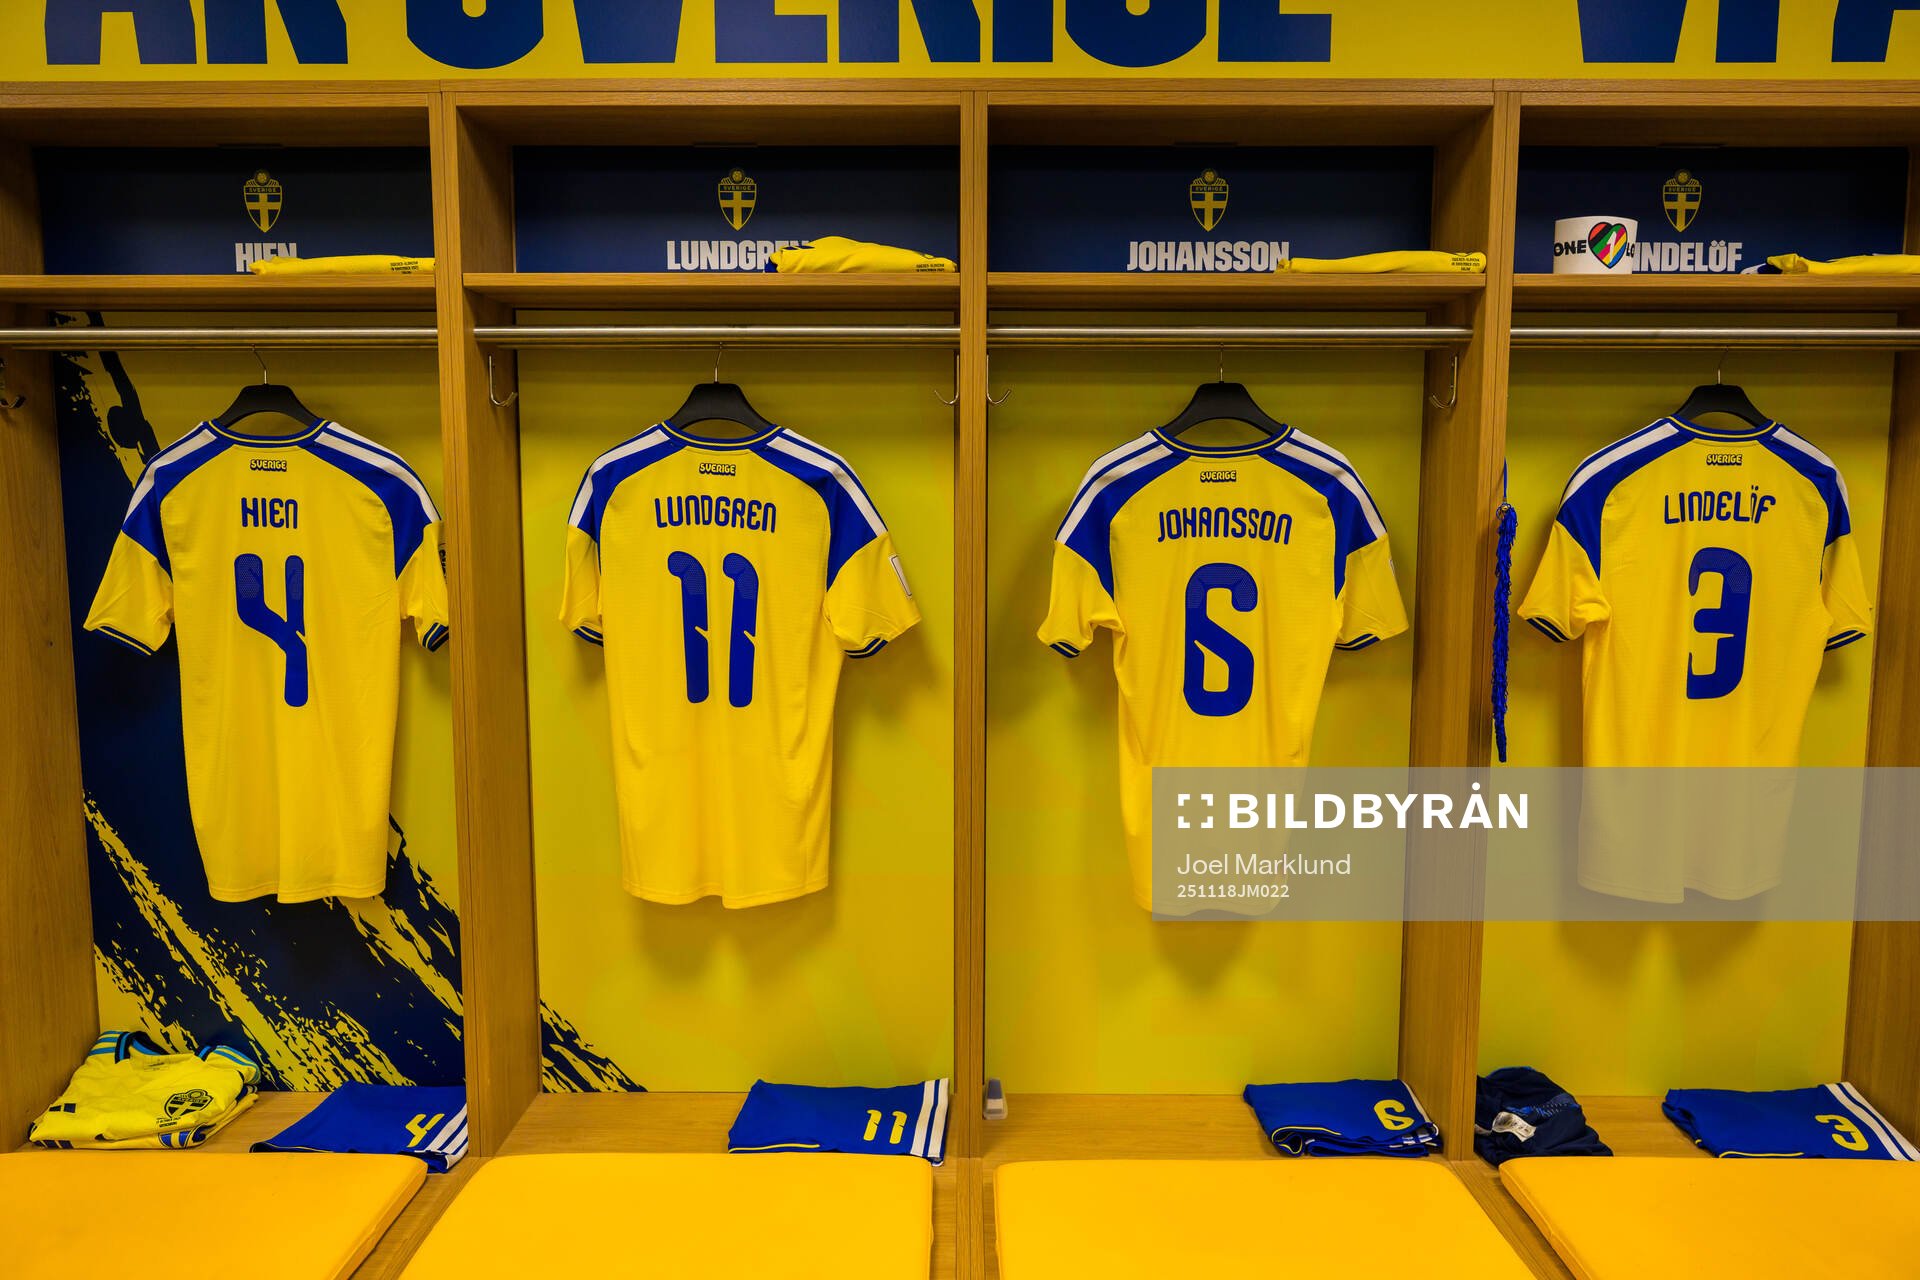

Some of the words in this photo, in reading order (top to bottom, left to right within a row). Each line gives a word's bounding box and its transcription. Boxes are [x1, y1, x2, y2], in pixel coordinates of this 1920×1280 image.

[666, 240, 810, 272] LUNDGR
[1126, 240, 1290, 272] JOHANSSON
[1554, 240, 1587, 257] ONE
[1632, 240, 1743, 272] INDELÖF
[250, 459, 287, 472] SVERIGE
[699, 462, 736, 476] SVERIGE
[1706, 454, 1743, 466] SVERIGE
[1200, 470, 1237, 483] SVERIGE
[241, 497, 298, 529] HIEN
[654, 495, 777, 533] LUNDGREN
[1157, 506, 1293, 545] JOHANSSON
[234, 553, 308, 707] 4
[667, 551, 759, 708] 11
[1686, 546, 1753, 700] 3
[1183, 562, 1258, 717] 6
[405, 1113, 445, 1147] 4
[863, 1109, 908, 1144] 11
[1373, 1099, 1415, 1131] 6
[1814, 1114, 1869, 1151] 3
